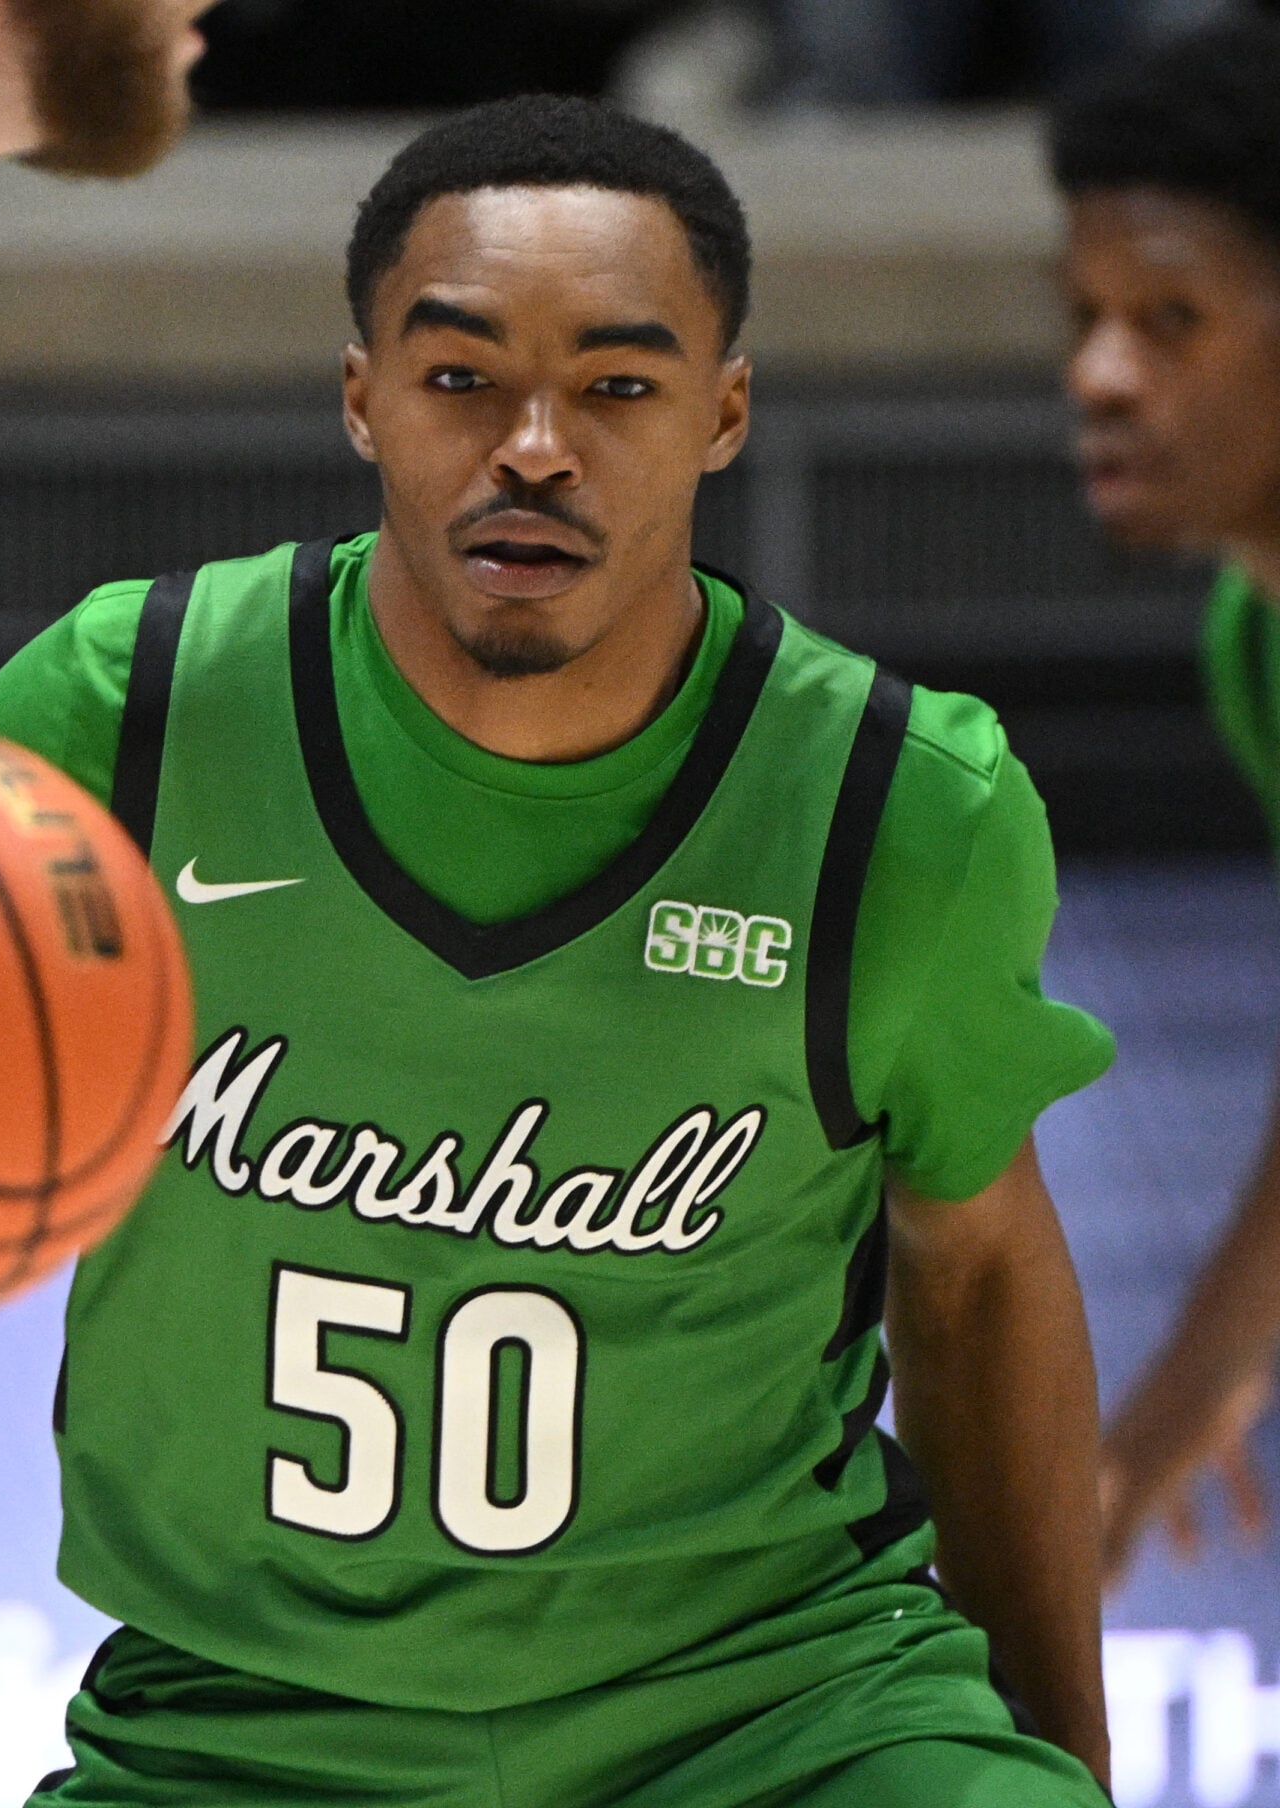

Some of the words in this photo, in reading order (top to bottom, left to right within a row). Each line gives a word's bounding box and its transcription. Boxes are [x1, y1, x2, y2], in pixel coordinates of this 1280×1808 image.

[645, 900, 792, 987] SBC
[156, 1024, 768, 1255] Marshall
[265, 1260, 586, 1558] 50
